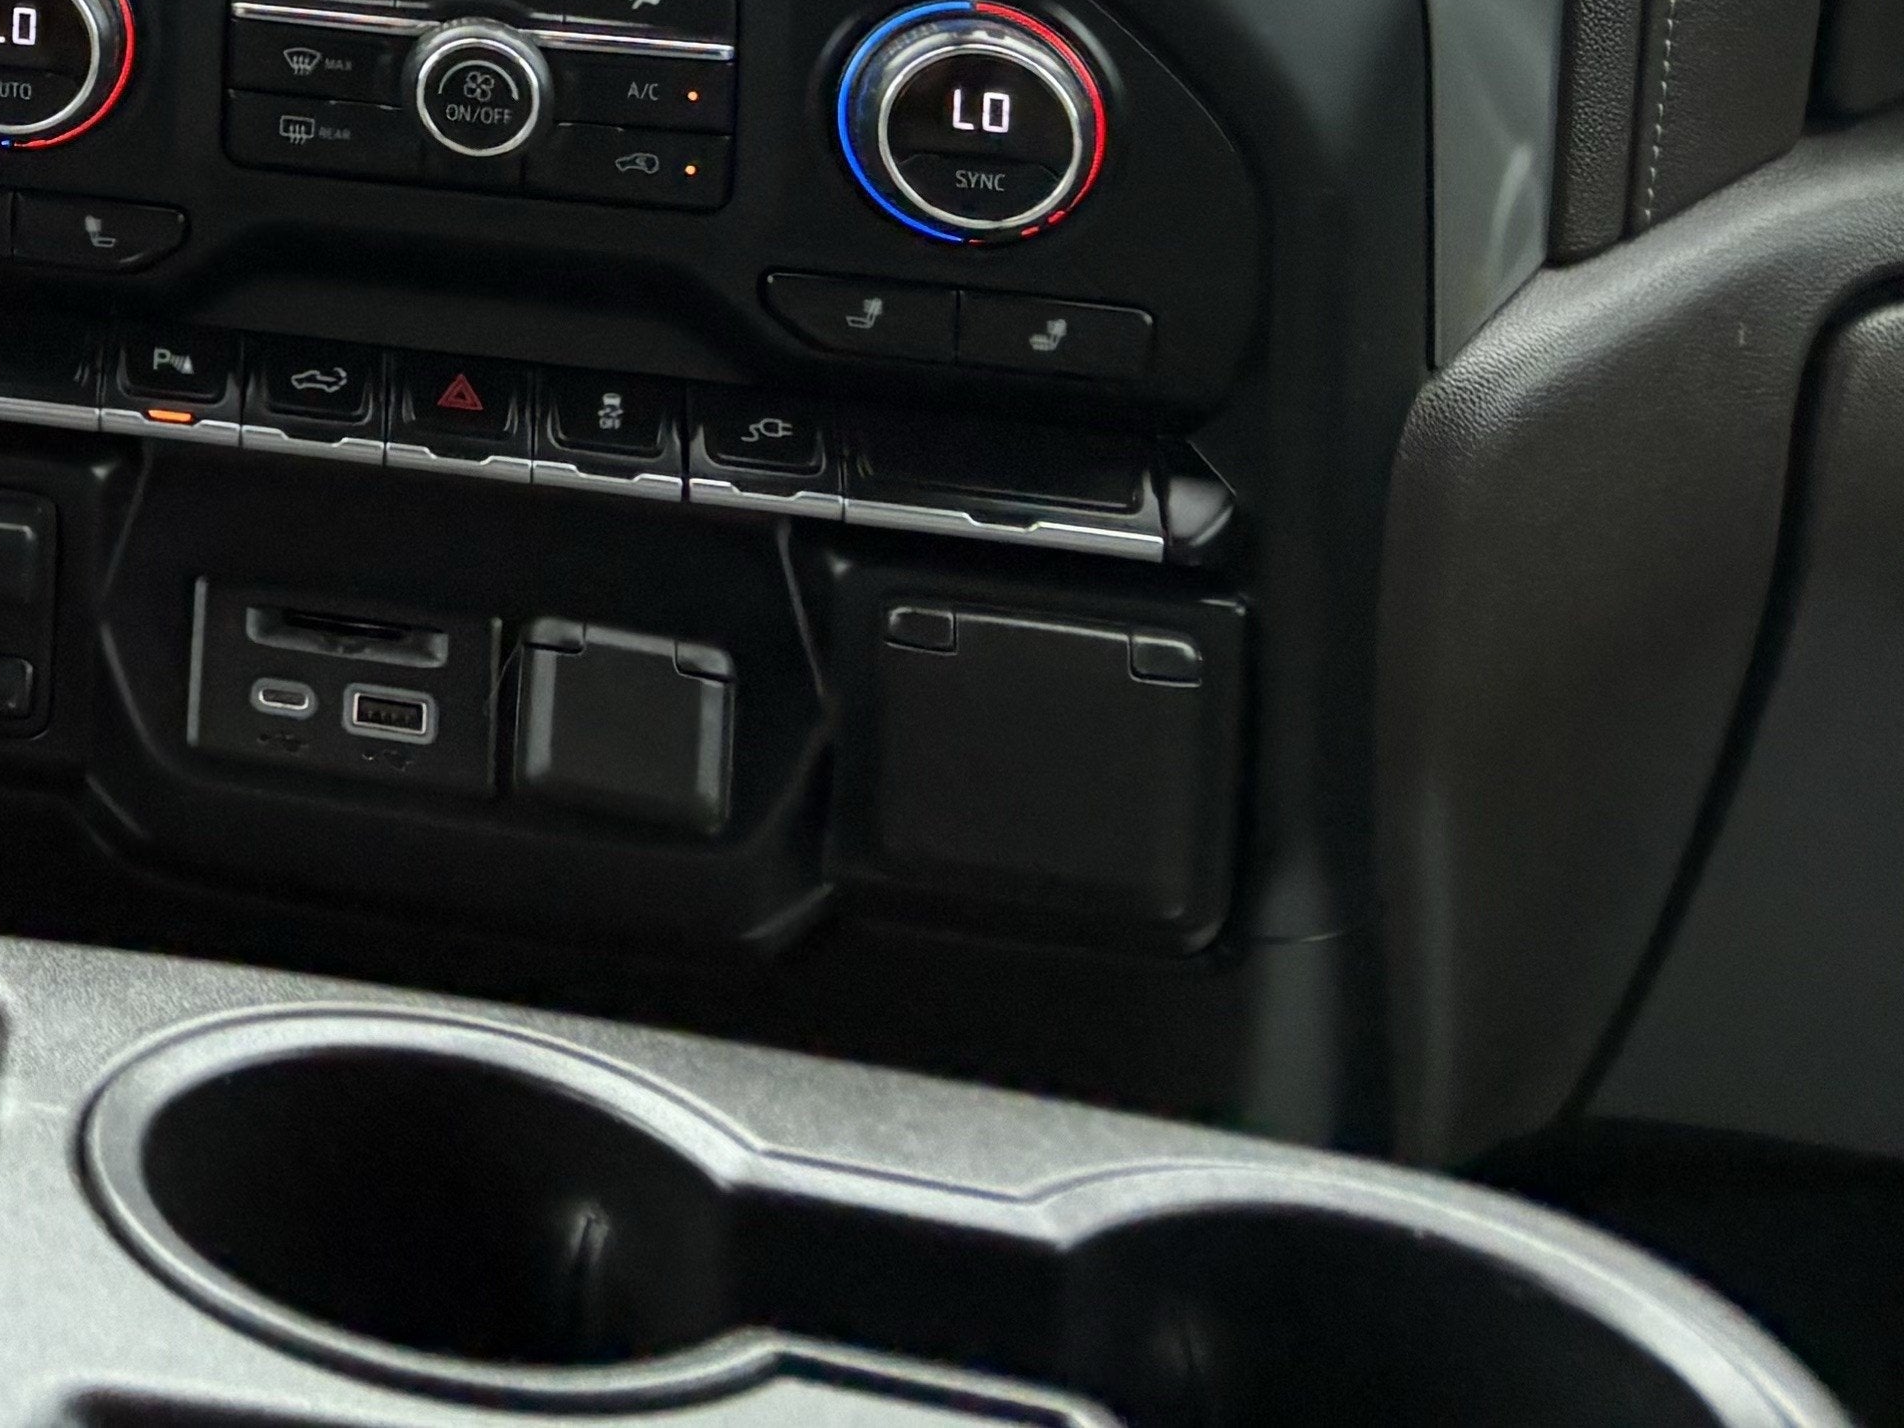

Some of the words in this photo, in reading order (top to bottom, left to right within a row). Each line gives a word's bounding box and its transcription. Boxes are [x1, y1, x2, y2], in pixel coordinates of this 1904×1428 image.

[324, 58, 353, 71] MAX
[627, 81, 659, 101] A/C
[445, 103, 513, 125] ON/OFF
[952, 88, 1011, 134] LO
[318, 126, 351, 140] REAR
[955, 169, 1006, 192] SYNC
[153, 346, 171, 370] P
[598, 417, 622, 430] OFF
